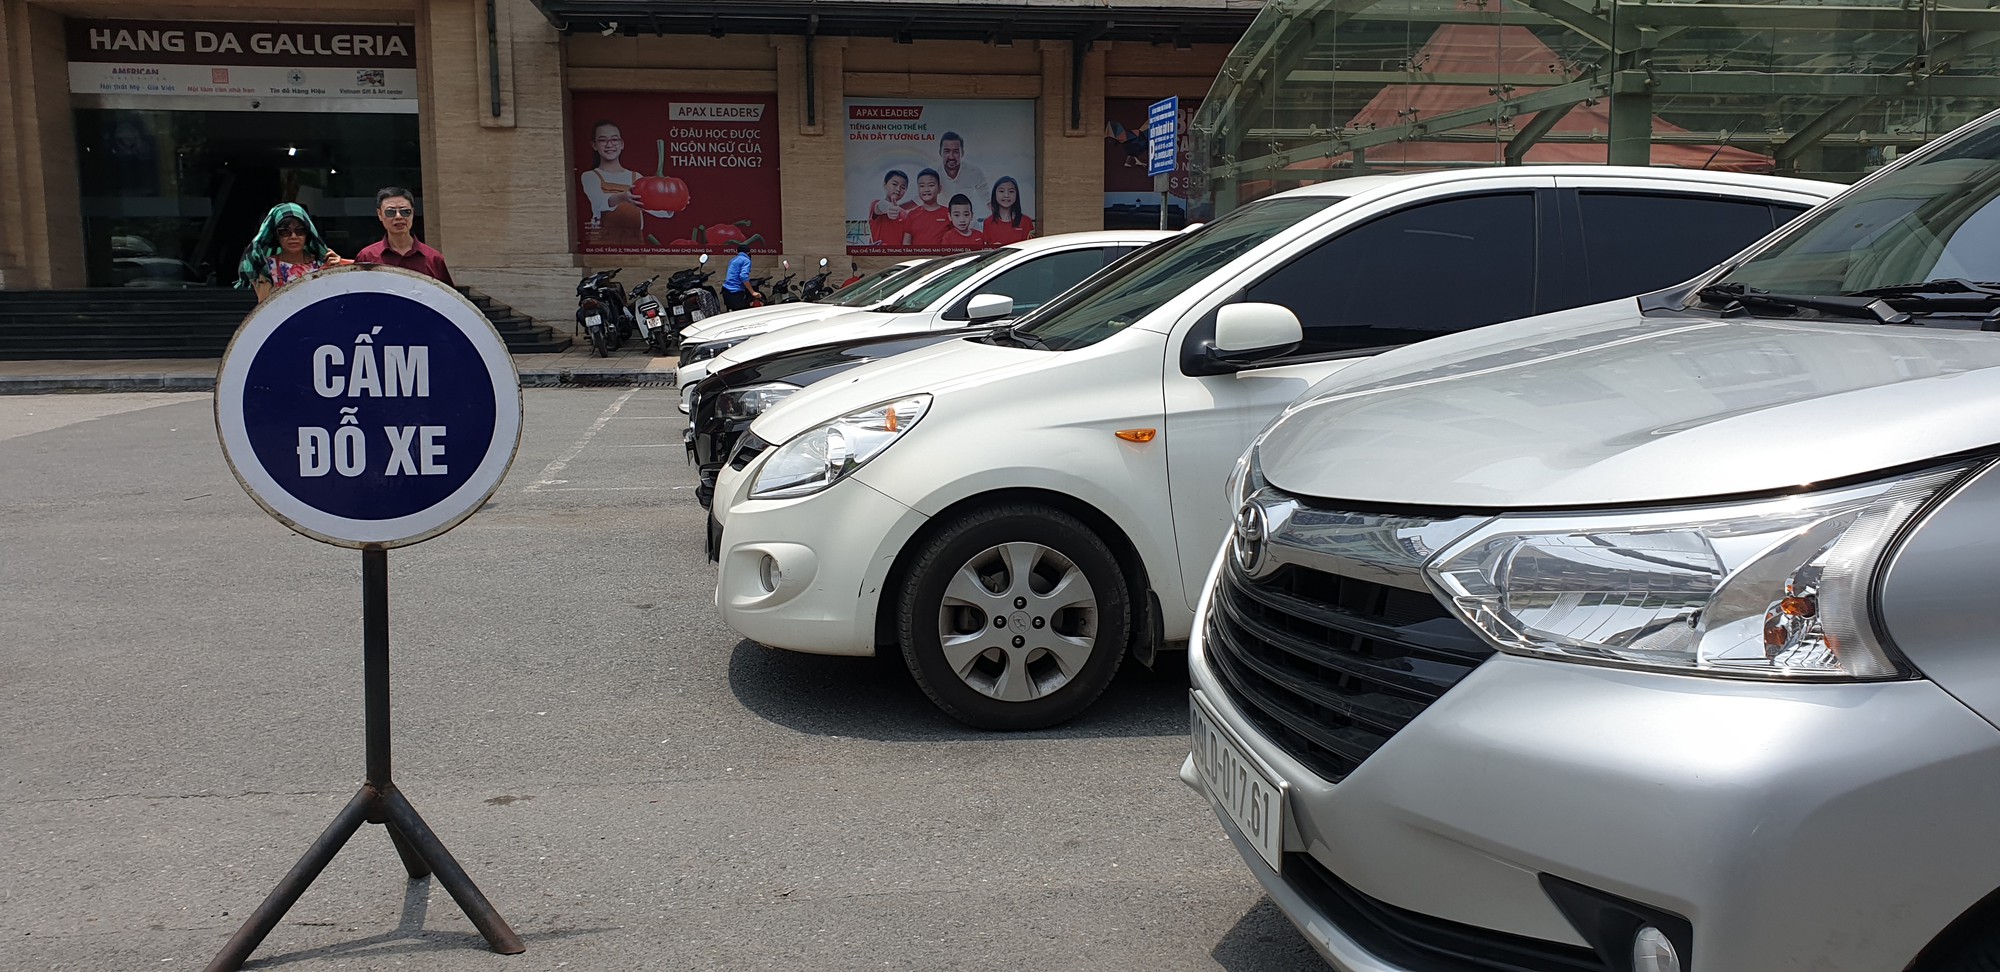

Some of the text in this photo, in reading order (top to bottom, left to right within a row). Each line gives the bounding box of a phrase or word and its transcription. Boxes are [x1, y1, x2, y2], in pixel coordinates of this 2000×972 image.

[90, 28, 408, 56] HANG DA GALLERIA
[112, 67, 160, 76] AMERICAN
[678, 106, 760, 118] APAX LEADERS
[856, 108, 919, 117] APAX LEADERS
[849, 122, 870, 131] TIẾNG
[903, 122, 917, 131] THẾ
[918, 122, 927, 132] HỆ
[670, 126, 761, 143] Ở ĐÂU HỌC ĐƯỢC
[850, 131, 935, 141] DẪN DẮT TƯƠNG LAI
[670, 140, 762, 154] NGÔN NGỮ CỦA
[670, 153, 763, 168] THÀNH CÔNG?
[312, 326, 430, 398] CẤM
[297, 406, 448, 478] ĐỖ XE
